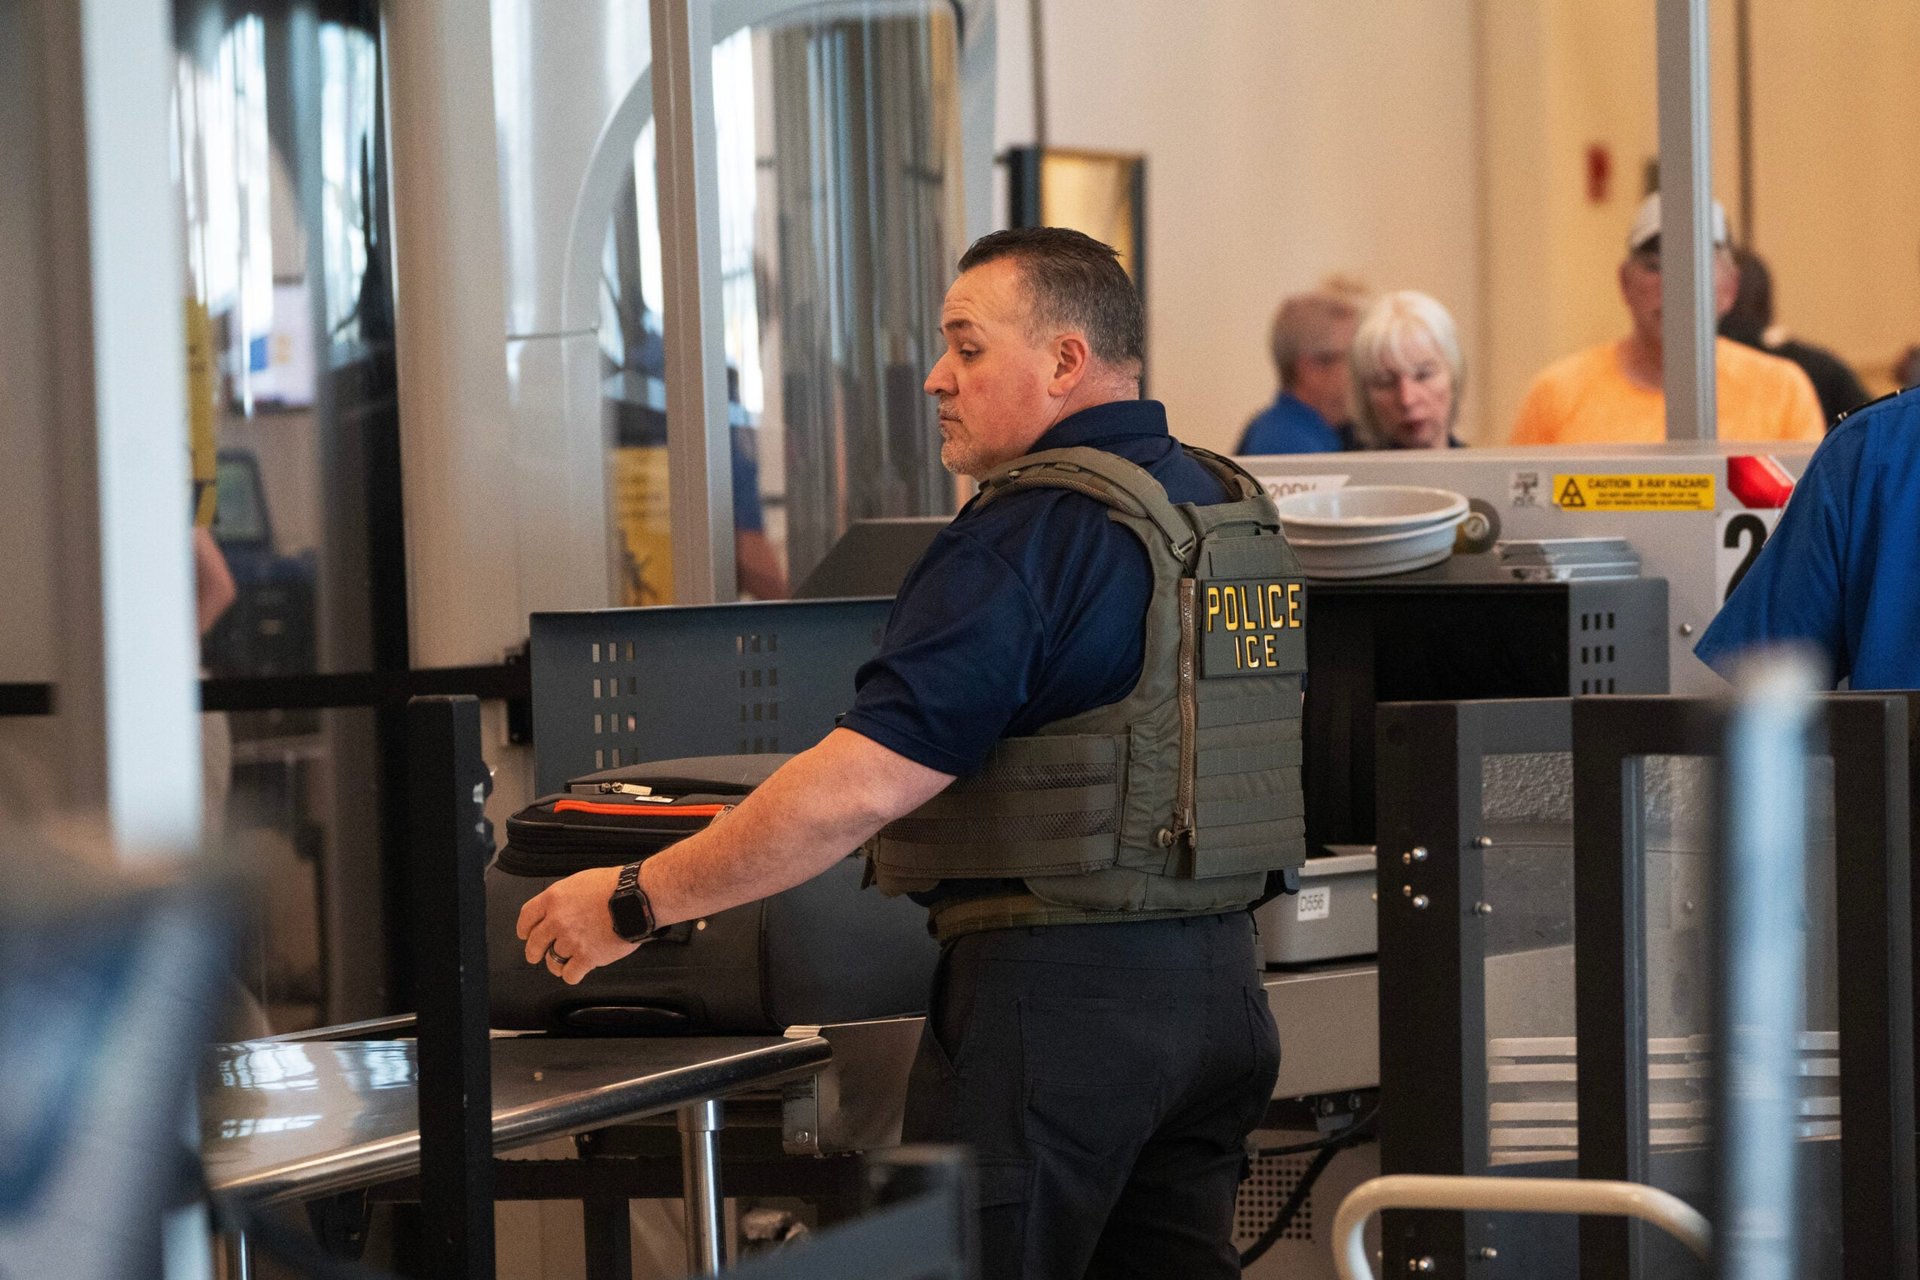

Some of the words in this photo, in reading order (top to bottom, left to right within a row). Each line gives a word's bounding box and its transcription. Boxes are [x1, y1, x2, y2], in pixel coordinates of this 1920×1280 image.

[1587, 478, 1631, 489] CAUTION
[1637, 478, 1666, 489] X-RAY
[1669, 478, 1710, 489] HAZARD
[1723, 513, 1768, 604] 2
[1207, 583, 1301, 633] POLICE
[1235, 633, 1279, 669] ICE
